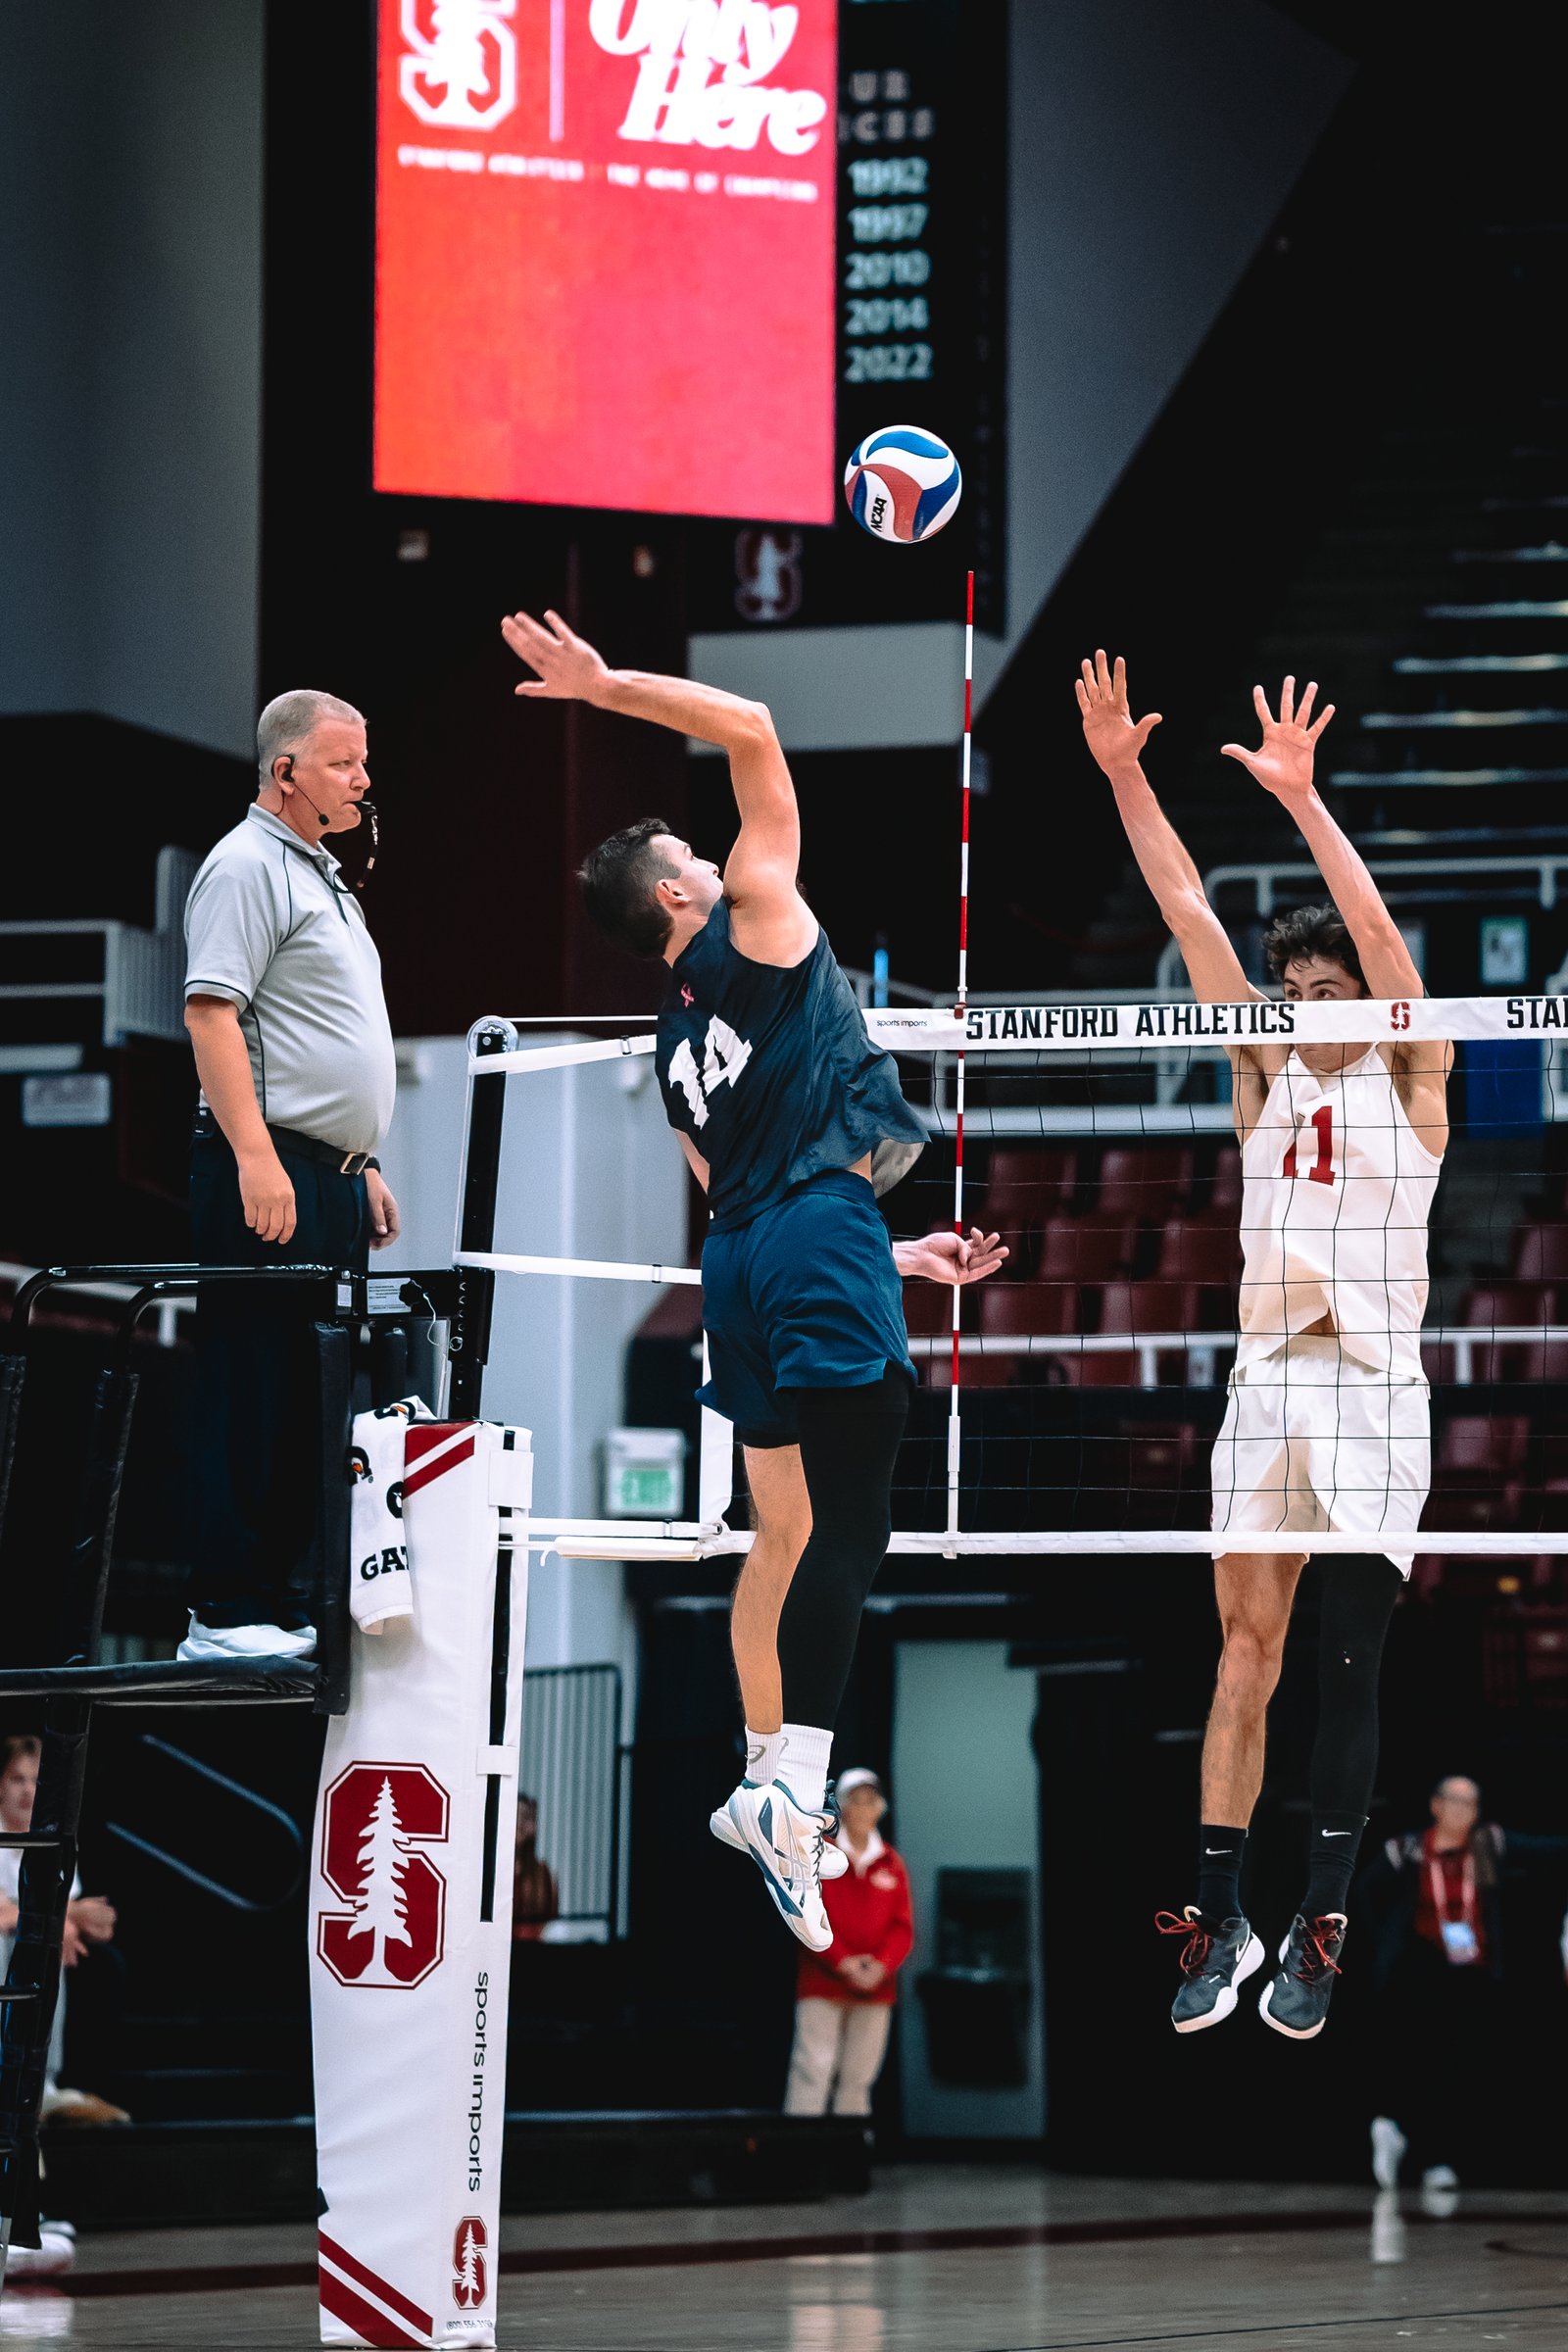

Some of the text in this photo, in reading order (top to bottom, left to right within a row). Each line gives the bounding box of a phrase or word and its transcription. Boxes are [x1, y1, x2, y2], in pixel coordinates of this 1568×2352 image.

[617, 53, 826, 155] Here
[845, 250, 931, 289] 2010
[845, 298, 929, 336] 2014
[845, 343, 933, 383] 2022
[870, 497, 887, 532] NCAA
[965, 1003, 1295, 1040] STANFORD ATHLETICS
[668, 1013, 753, 1130] 14
[467, 1971, 489, 2192] sports imports
